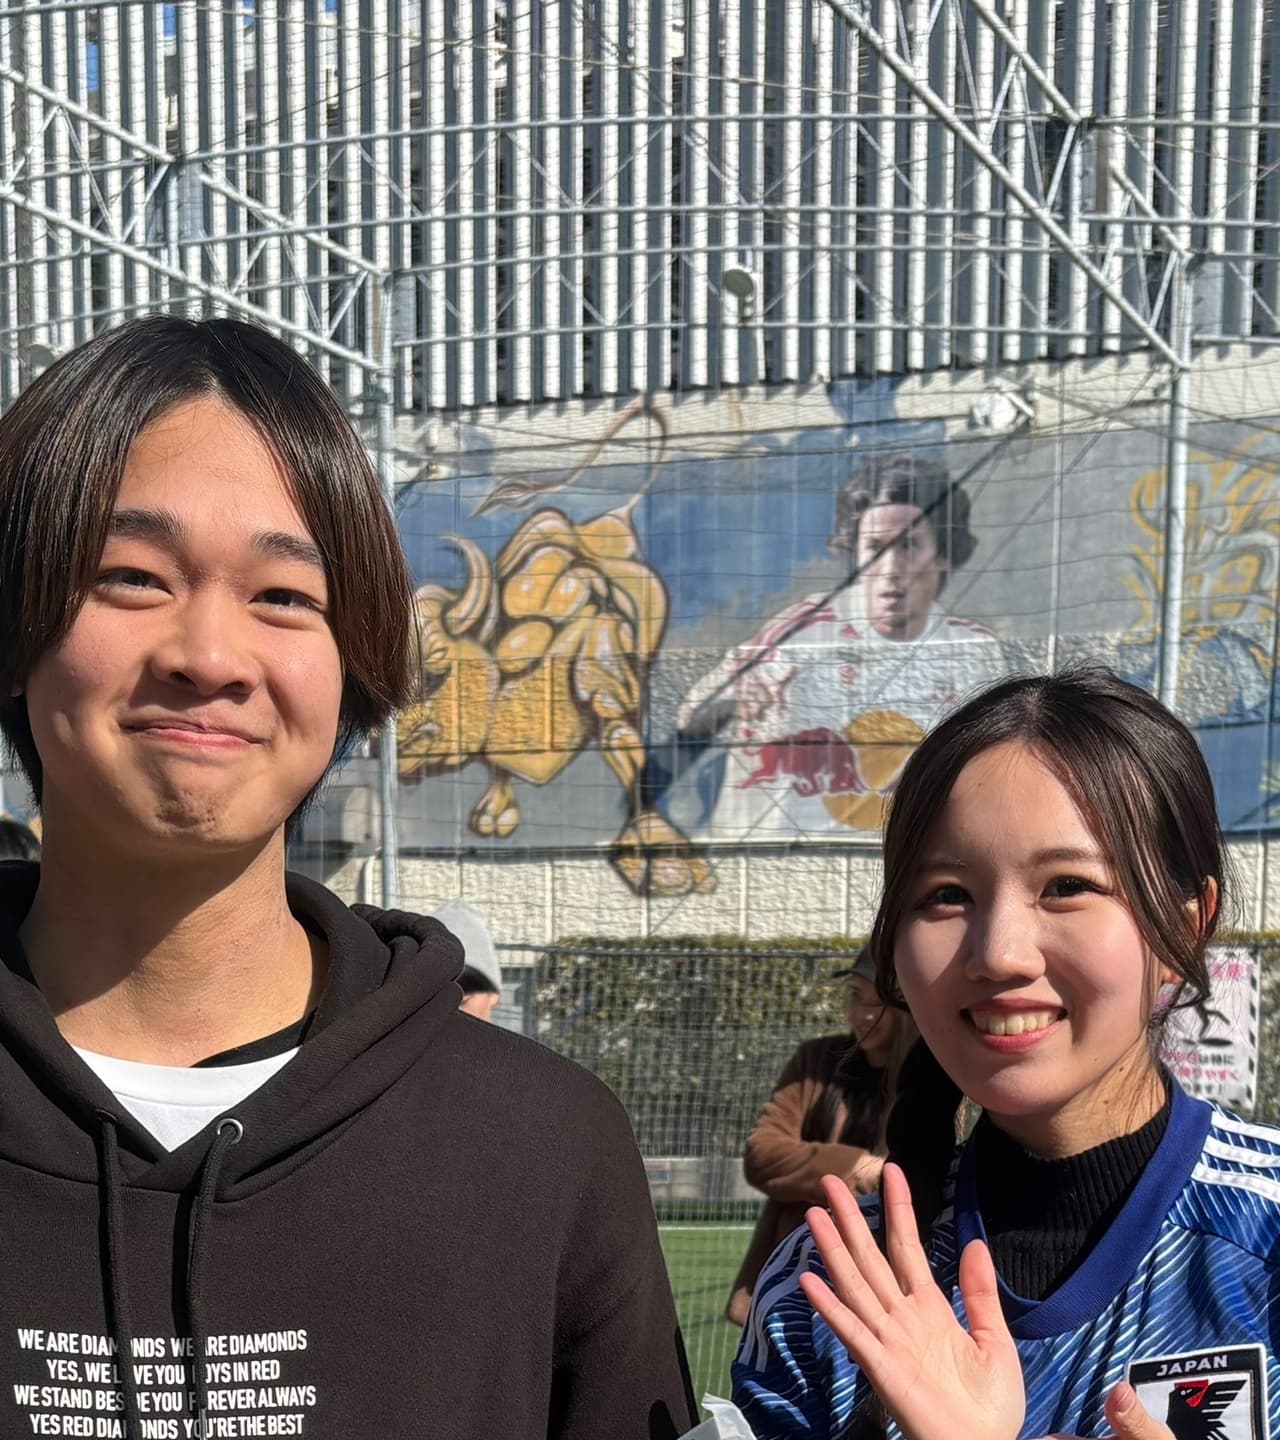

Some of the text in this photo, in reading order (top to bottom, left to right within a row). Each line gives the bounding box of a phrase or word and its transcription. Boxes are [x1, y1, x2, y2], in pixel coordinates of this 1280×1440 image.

[17, 1328, 307, 1358] WE ARE DIAMNDS WE RE DIAMONDS
[46, 1359, 83, 1383] YES,
[84, 1361, 111, 1383] WE
[113, 1363, 153, 1386] LVE
[154, 1364, 186, 1386] YOU
[233, 1361, 249, 1382] IN
[250, 1359, 281, 1381] RED
[1156, 1354, 1228, 1377] JAPAN
[13, 1384, 317, 1413] WE STAND BESE YOU FREVER ALWAYS
[29, 1413, 61, 1436] YES
[62, 1415, 94, 1437] RED
[96, 1417, 179, 1440] DIANDS
[238, 1415, 267, 1437] THE
[267, 1413, 305, 1436] BEST
